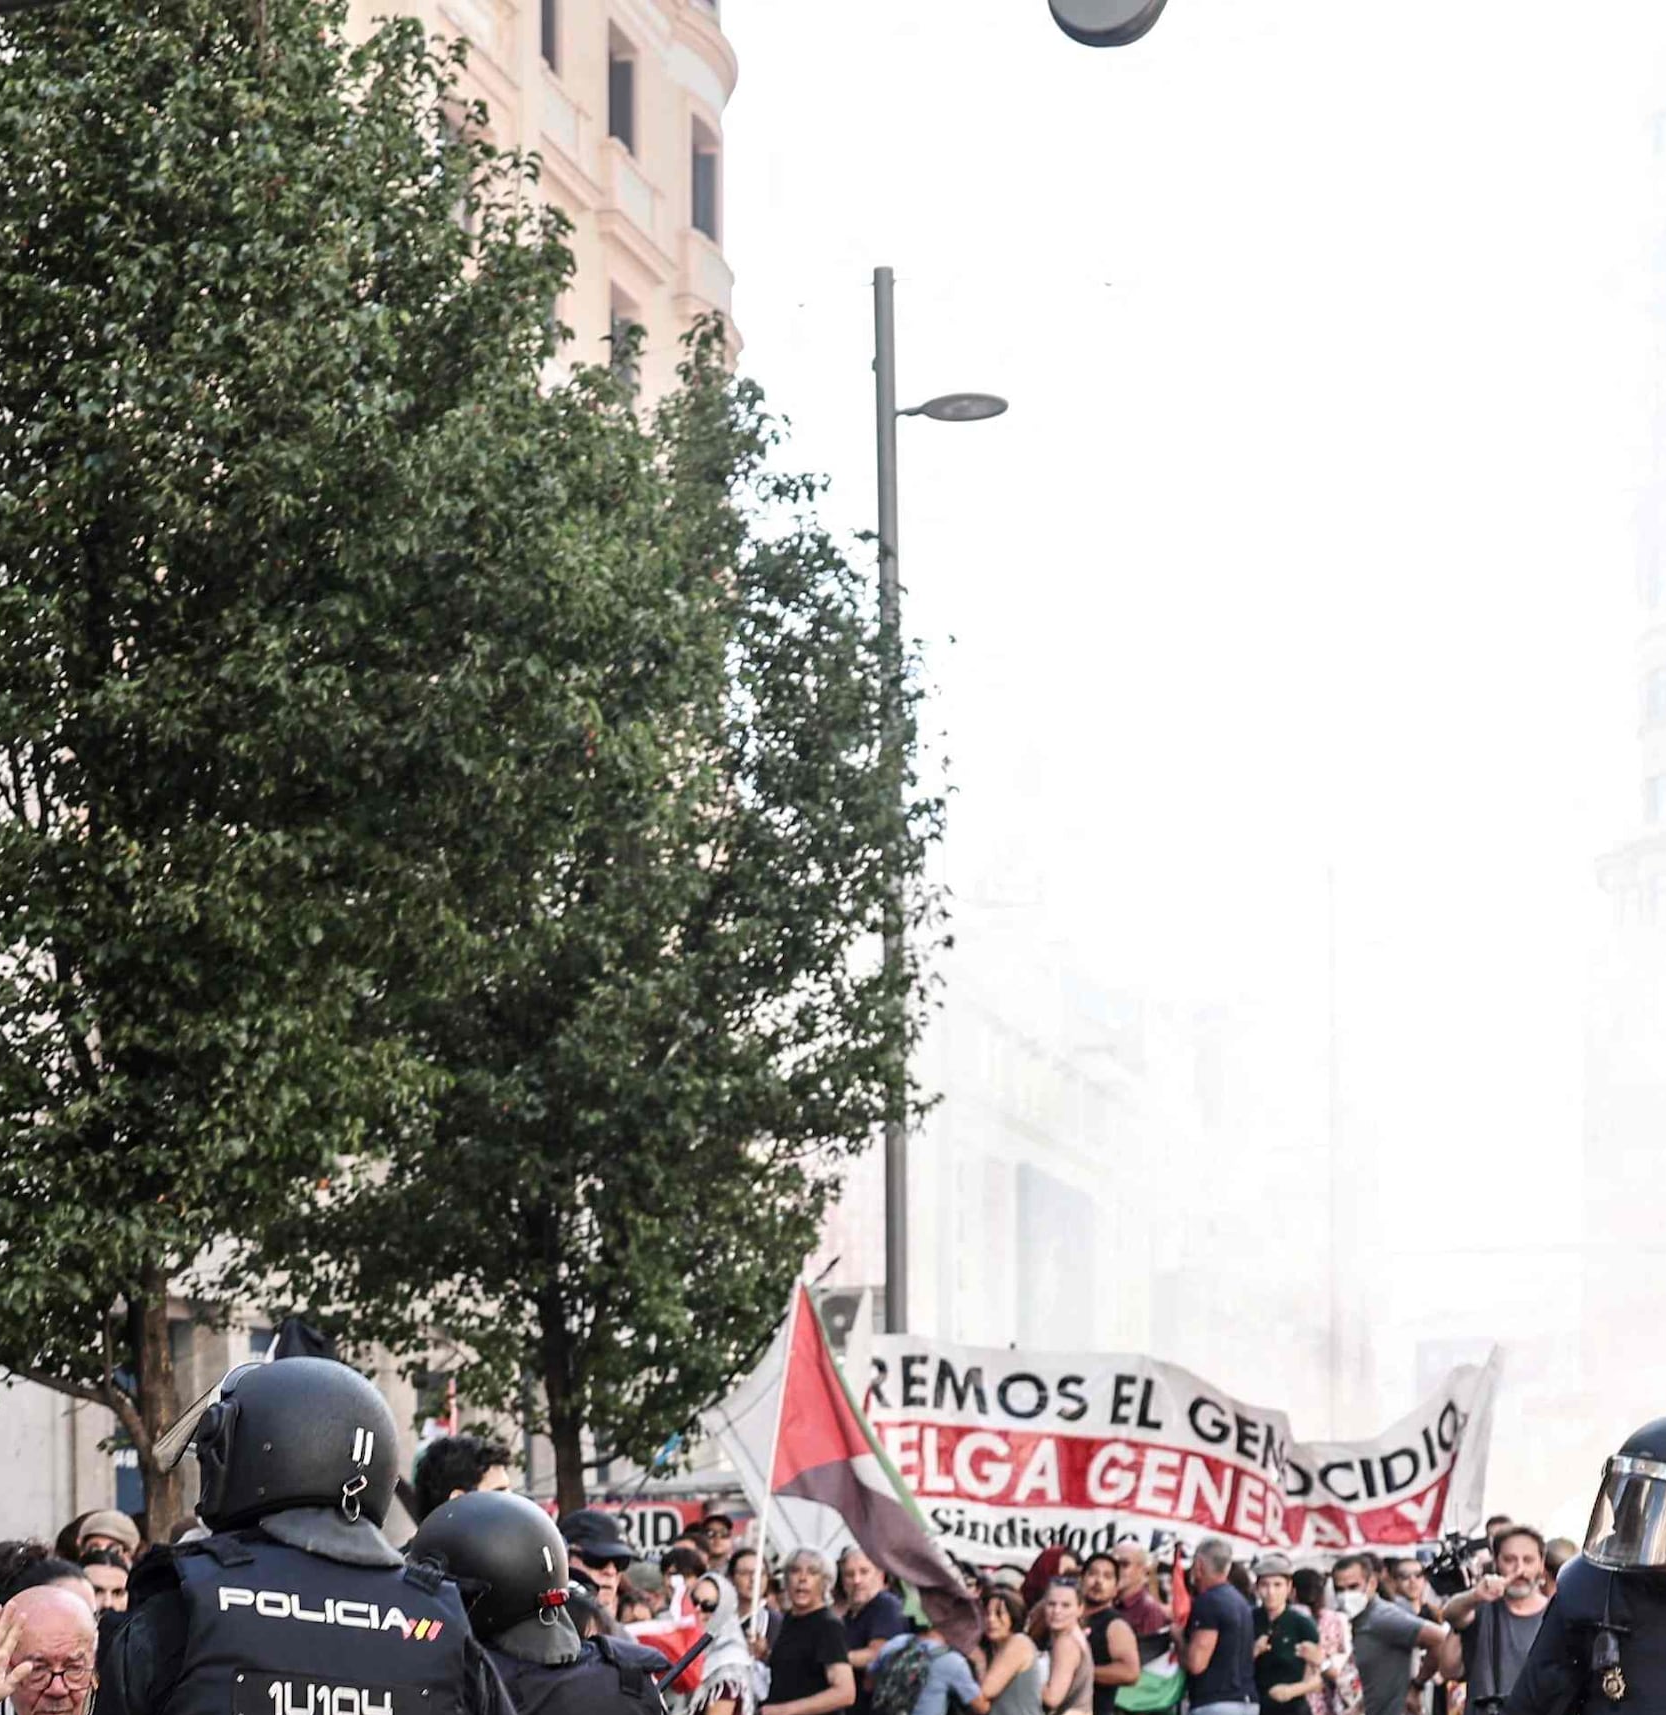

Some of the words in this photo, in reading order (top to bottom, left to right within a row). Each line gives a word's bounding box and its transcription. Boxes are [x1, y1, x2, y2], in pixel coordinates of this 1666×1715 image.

[871, 1355, 1088, 1422] REMOS
[1110, 1374, 1162, 1430] EL
[884, 1426, 1064, 1502] ELGA
[218, 1586, 411, 1634] POLICIA
